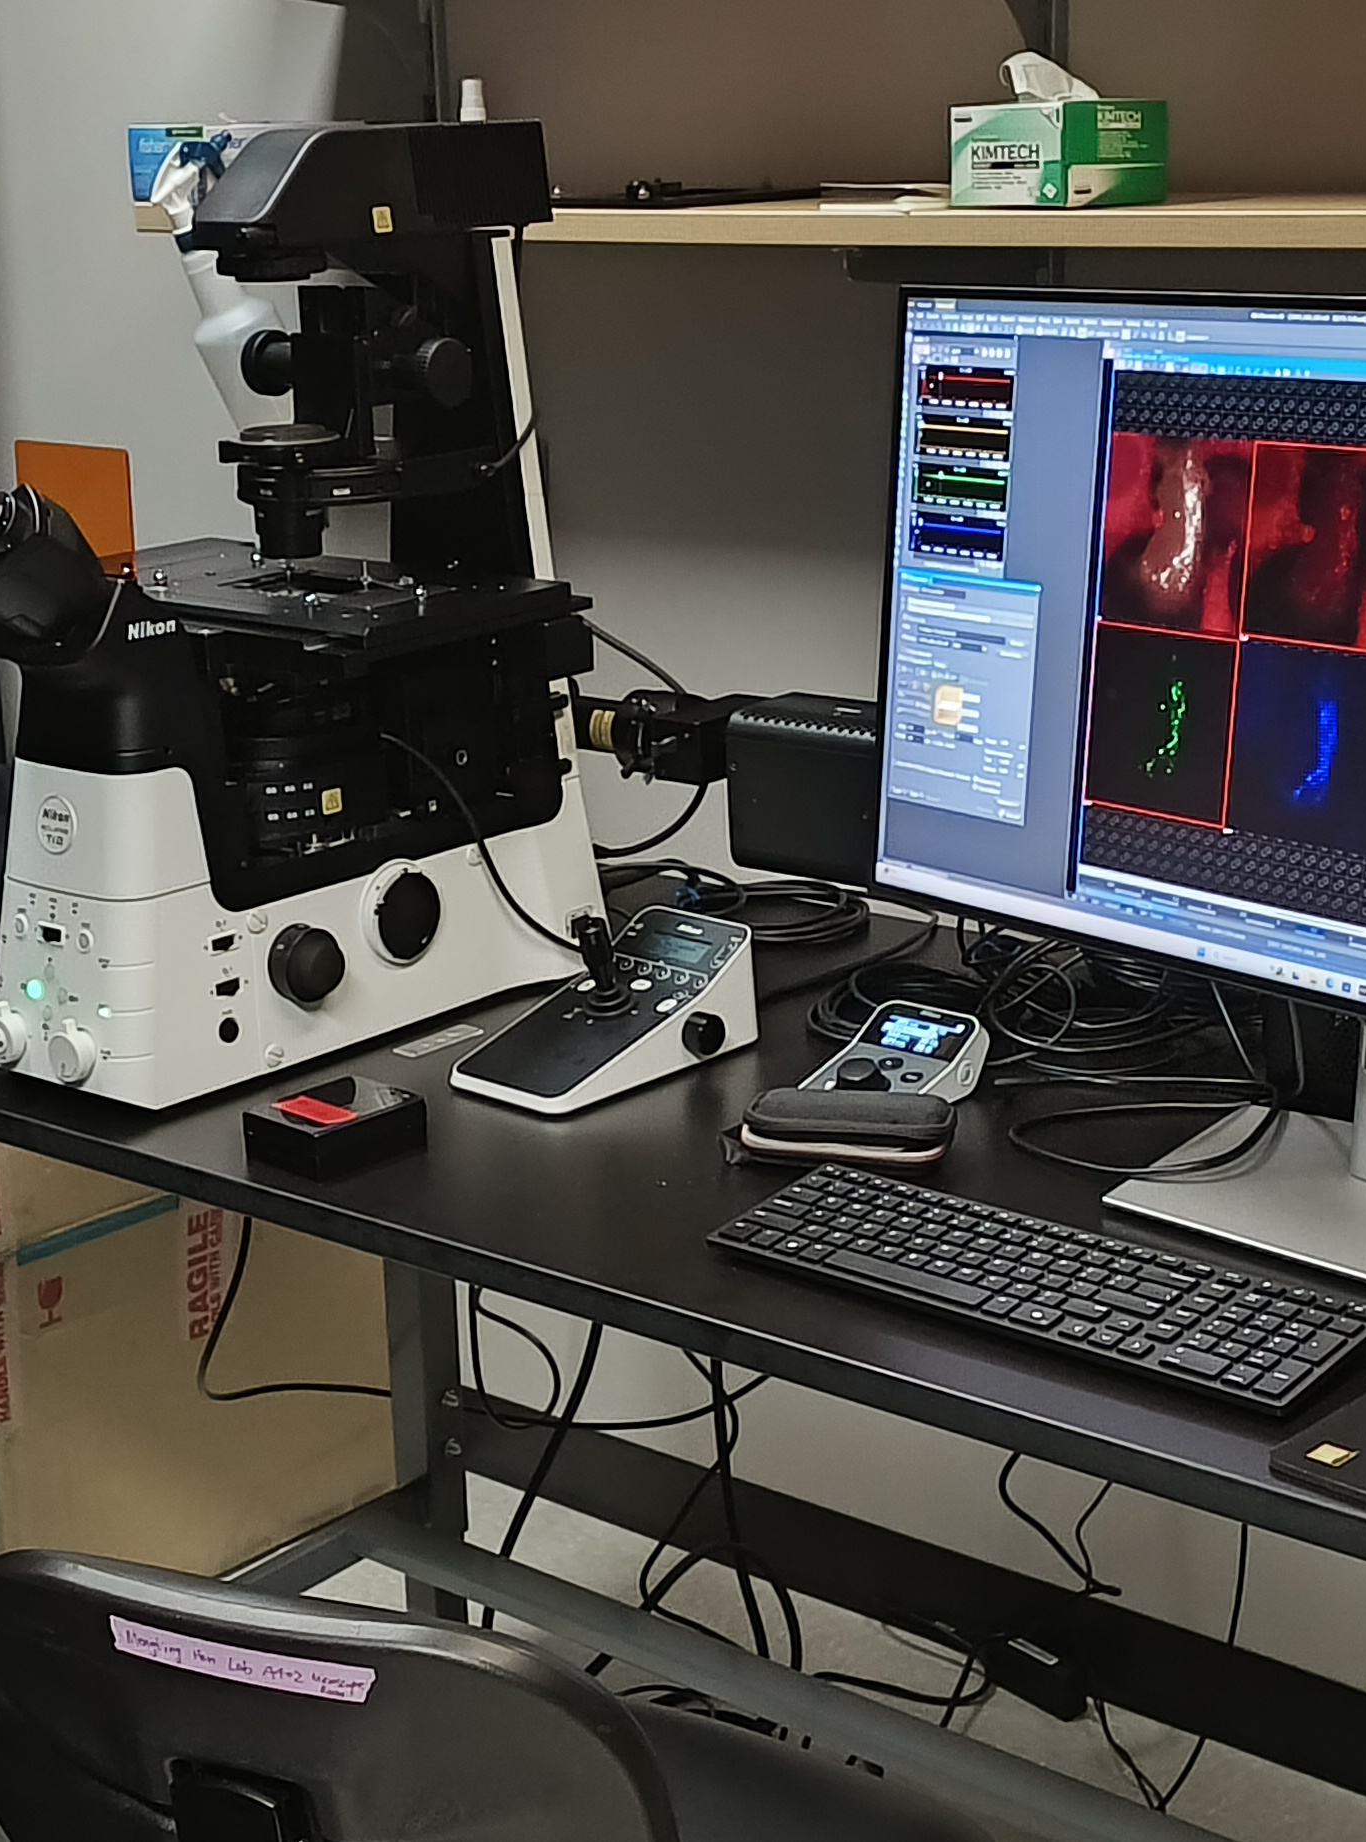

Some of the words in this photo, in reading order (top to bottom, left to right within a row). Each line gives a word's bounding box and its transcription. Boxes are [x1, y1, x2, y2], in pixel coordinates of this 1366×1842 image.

[971, 144, 1040, 160] KIMTECH
[127, 619, 176, 641] Nikon
[228, 1656, 252, 1675] Lab
